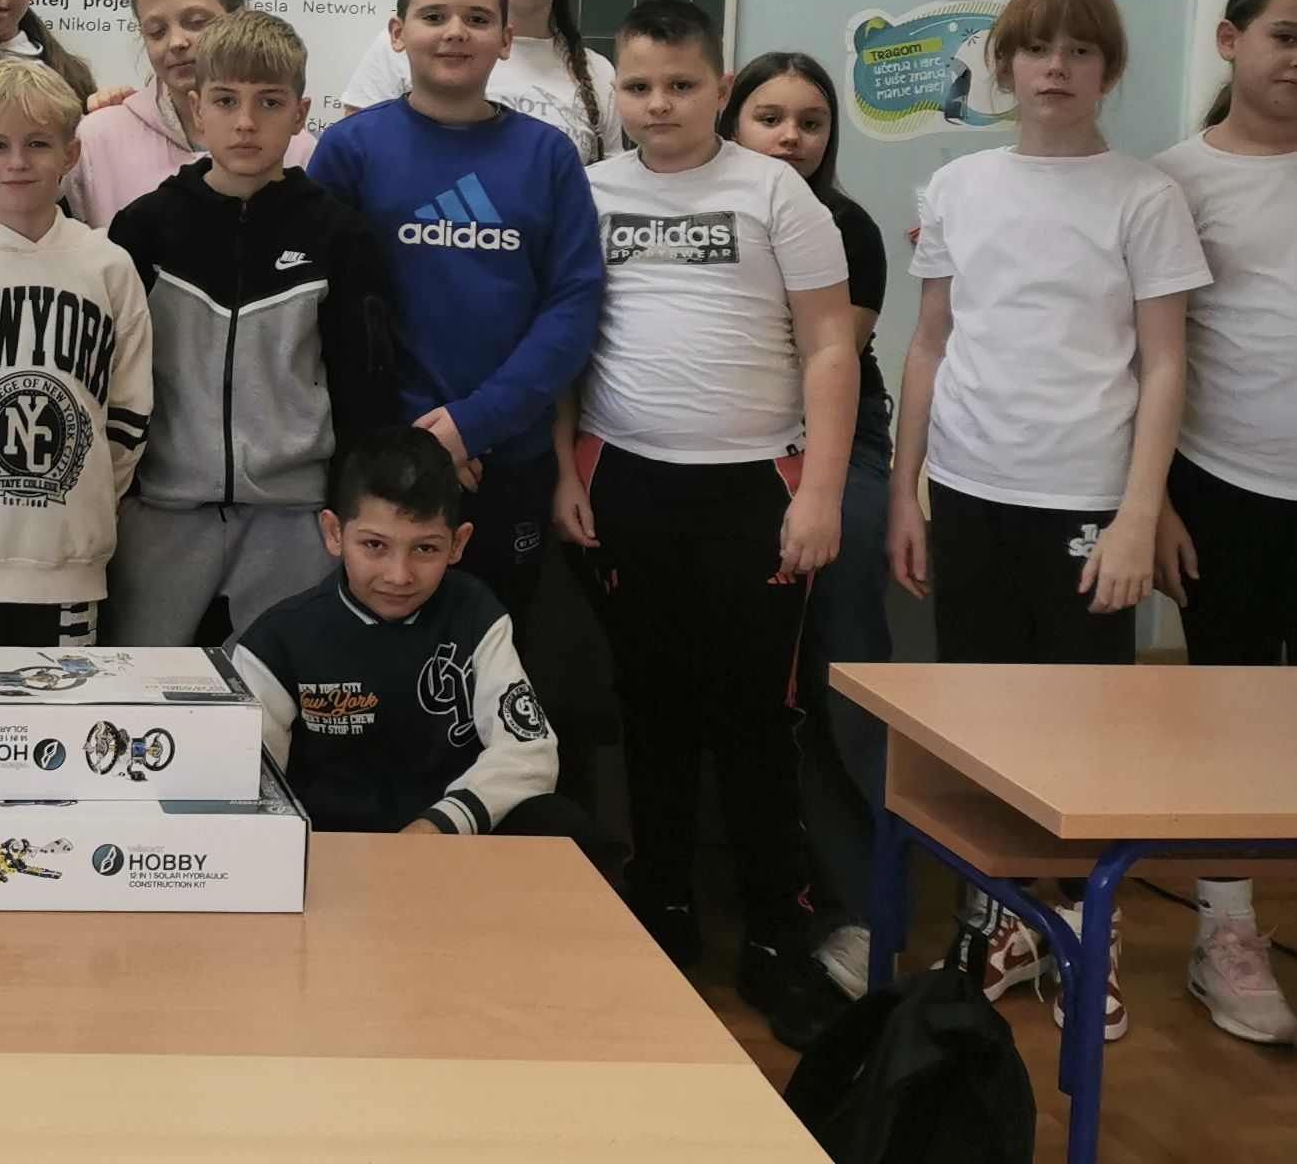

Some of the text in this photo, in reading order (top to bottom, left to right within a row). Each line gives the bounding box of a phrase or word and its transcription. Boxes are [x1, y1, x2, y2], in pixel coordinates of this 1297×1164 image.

[303, 0, 376, 15] Network
[59, 17, 111, 32] Nikola
[116, 19, 140, 32] Te
[323, 95, 346, 109] Fa
[398, 219, 521, 251] adidas
[611, 219, 731, 247] adidas
[280, 250, 306, 263] NIKE
[22, 378, 40, 389] OF
[42, 380, 66, 402] NEW
[63, 405, 76, 441] YORK
[56, 445, 73, 476] CITY
[342, 682, 362, 693] CITY
[328, 689, 379, 717] York
[350, 713, 375, 724] CREW
[328, 725, 349, 734] STOP
[129, 854, 207, 871] HOBBY
